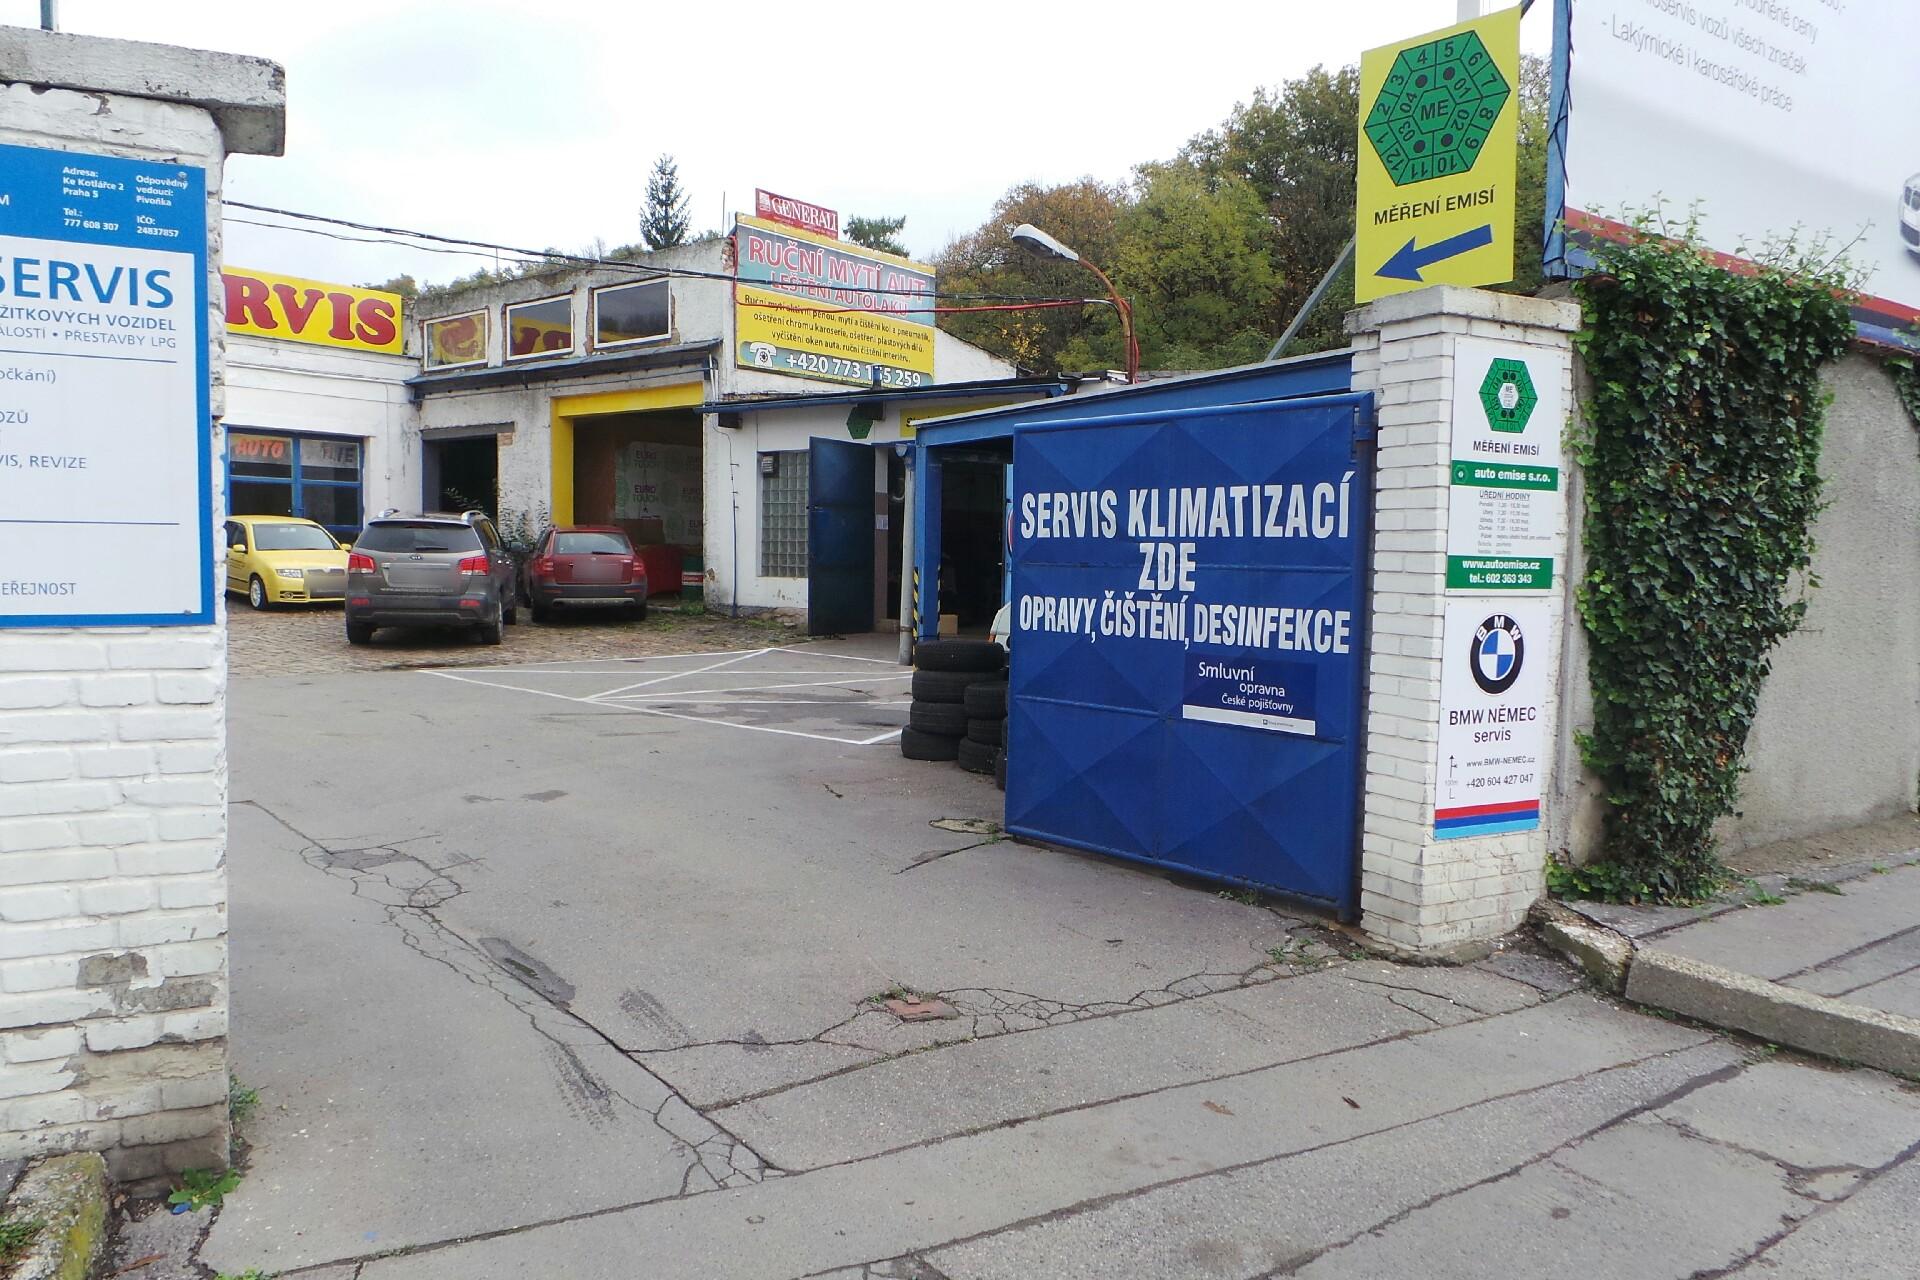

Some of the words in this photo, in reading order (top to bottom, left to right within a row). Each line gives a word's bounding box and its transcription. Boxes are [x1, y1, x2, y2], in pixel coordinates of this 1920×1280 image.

[1792, 15, 1818, 45] ceny
[1443, 41, 1455, 58] 5
[1699, 12, 1729, 40] vozů
[1731, 27, 1765, 57] všech
[1768, 46, 1807, 77] značek
[1416, 49, 1429, 65] 4
[1468, 51, 1483, 66] 6
[1612, 13, 1684, 65] Lakýrnické
[1693, 50, 1759, 98] karosářské
[1760, 86, 1793, 113] práce
[1390, 74, 1405, 86] 3
[1453, 78, 1473, 99] 01
[1480, 72, 1498, 88] 7
[1376, 102, 1391, 116] 2
[1399, 91, 1418, 114] 04
[1420, 99, 1449, 121] ME
[1450, 108, 1470, 132] 02
[1478, 107, 1494, 121] 8
[1375, 131, 1389, 145] 1
[1398, 120, 1416, 142] 03
[1464, 136, 1480, 150] 9
[1386, 148, 1404, 171] 12
[1437, 154, 1458, 173] 10
[63, 166, 98, 178] Adresa:
[1410, 162, 1428, 180] 11
[63, 177, 76, 186] Ke
[118, 183, 124, 191] 2
[63, 188, 90, 198] Praha
[92, 190, 99, 198] 5
[1373, 195, 1442, 226] MĚŘENÍ
[1445, 184, 1496, 212] EMISÍ
[772, 197, 838, 232] GENERALI
[64, 219, 81, 227] 777
[83, 220, 101, 229] 608
[102, 222, 119, 231] 307
[748, 235, 825, 278] RUČNÍ
[829, 255, 884, 293] MYTÍ
[886, 271, 926, 303] AUT
[770, 271, 833, 300] LEŠTĚNÍ
[835, 289, 909, 316] AUTOLAKU
[106, 314, 176, 331] VOZIDEL
[785, 318, 814, 331] chromu
[65, 329, 145, 346] PŘESTAVBY
[151, 337, 176, 349] LPG
[805, 336, 823, 347] oken
[786, 353, 829, 374] +420
[832, 358, 861, 379] 773
[895, 370, 921, 387] 259
[235, 438, 286, 459] AUTO
[1473, 440, 1511, 454] MĚŘENÍ
[1513, 444, 1540, 456] EMISÍ
[29, 455, 87, 469] REVIZE
[1474, 468, 1496, 479] auto
[1497, 469, 1526, 480] emise
[1528, 473, 1551, 482] s.r.o.
[1020, 489, 1118, 539] SERVIS
[1127, 470, 1355, 538] KLIMATIZACÍ
[1505, 492, 1530, 500] HODINY
[1137, 542, 1197, 592] ZDE
[1462, 560, 1541, 570] www.autoemise.cz
[1485, 574, 1500, 583] 602
[1517, 574, 1532, 584] 343
[1019, 594, 1097, 644] OPRAVY,
[1100, 590, 1190, 650] ČIŠTĚNÍ,
[1193, 603, 1350, 654] DESINFEKCE
[1475, 615, 1522, 643] BMW
[1198, 661, 1256, 682] Smluvní
[1239, 682, 1286, 697] opravna
[1221, 692, 1246, 706] České
[1248, 698, 1294, 715] pojišťovny
[1449, 708, 1485, 726] BMW
[1487, 704, 1537, 723] NĚMEC
[1474, 726, 1512, 744] servis
[1466, 777, 1486, 788] +420
[1487, 776, 1501, 786] 604
[1503, 774, 1518, 785] 427
[1519, 773, 1534, 784] 047
